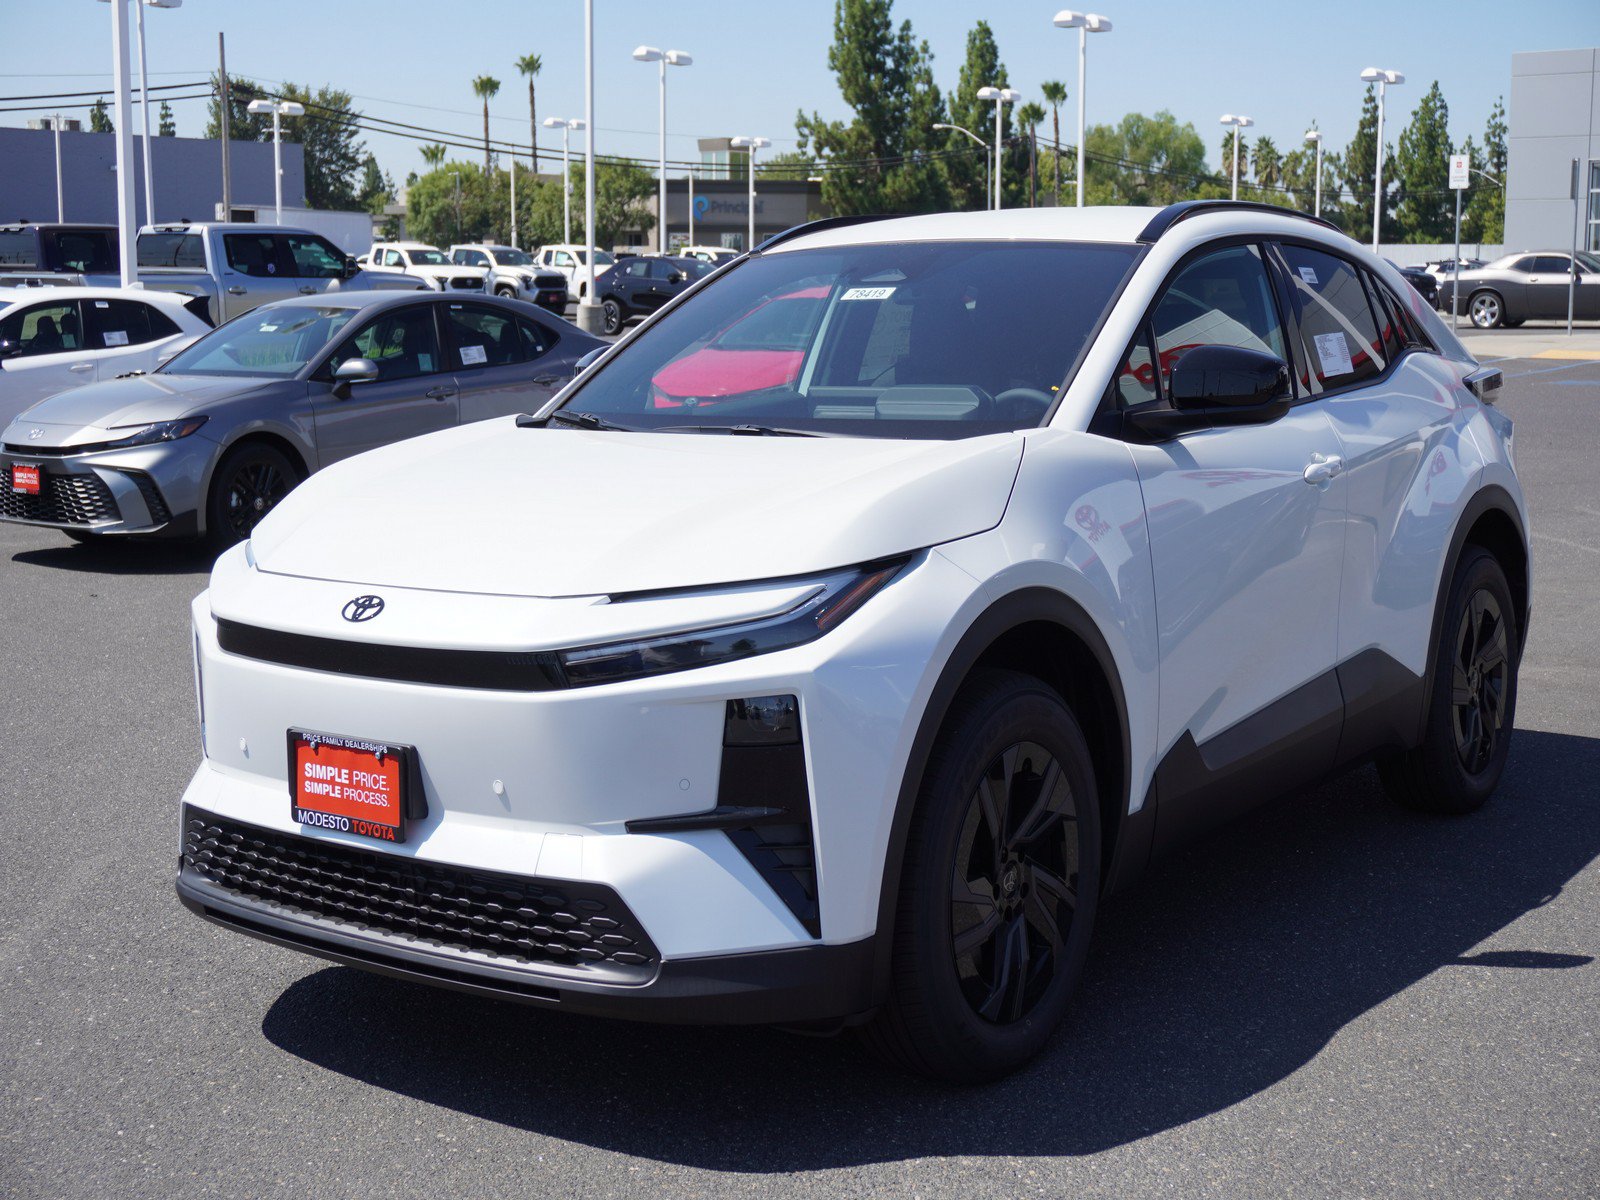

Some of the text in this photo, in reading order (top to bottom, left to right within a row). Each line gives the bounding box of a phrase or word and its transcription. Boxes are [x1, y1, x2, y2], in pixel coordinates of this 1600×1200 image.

[849, 289, 887, 299] 78419
[302, 733, 388, 754] PRICE FAMILY DEALERSHIPS
[304, 762, 390, 792] SIMPLE PRICE.
[304, 780, 391, 807] SIMPLE PROCESS.
[298, 809, 395, 841] MODESTO TOYOTA
